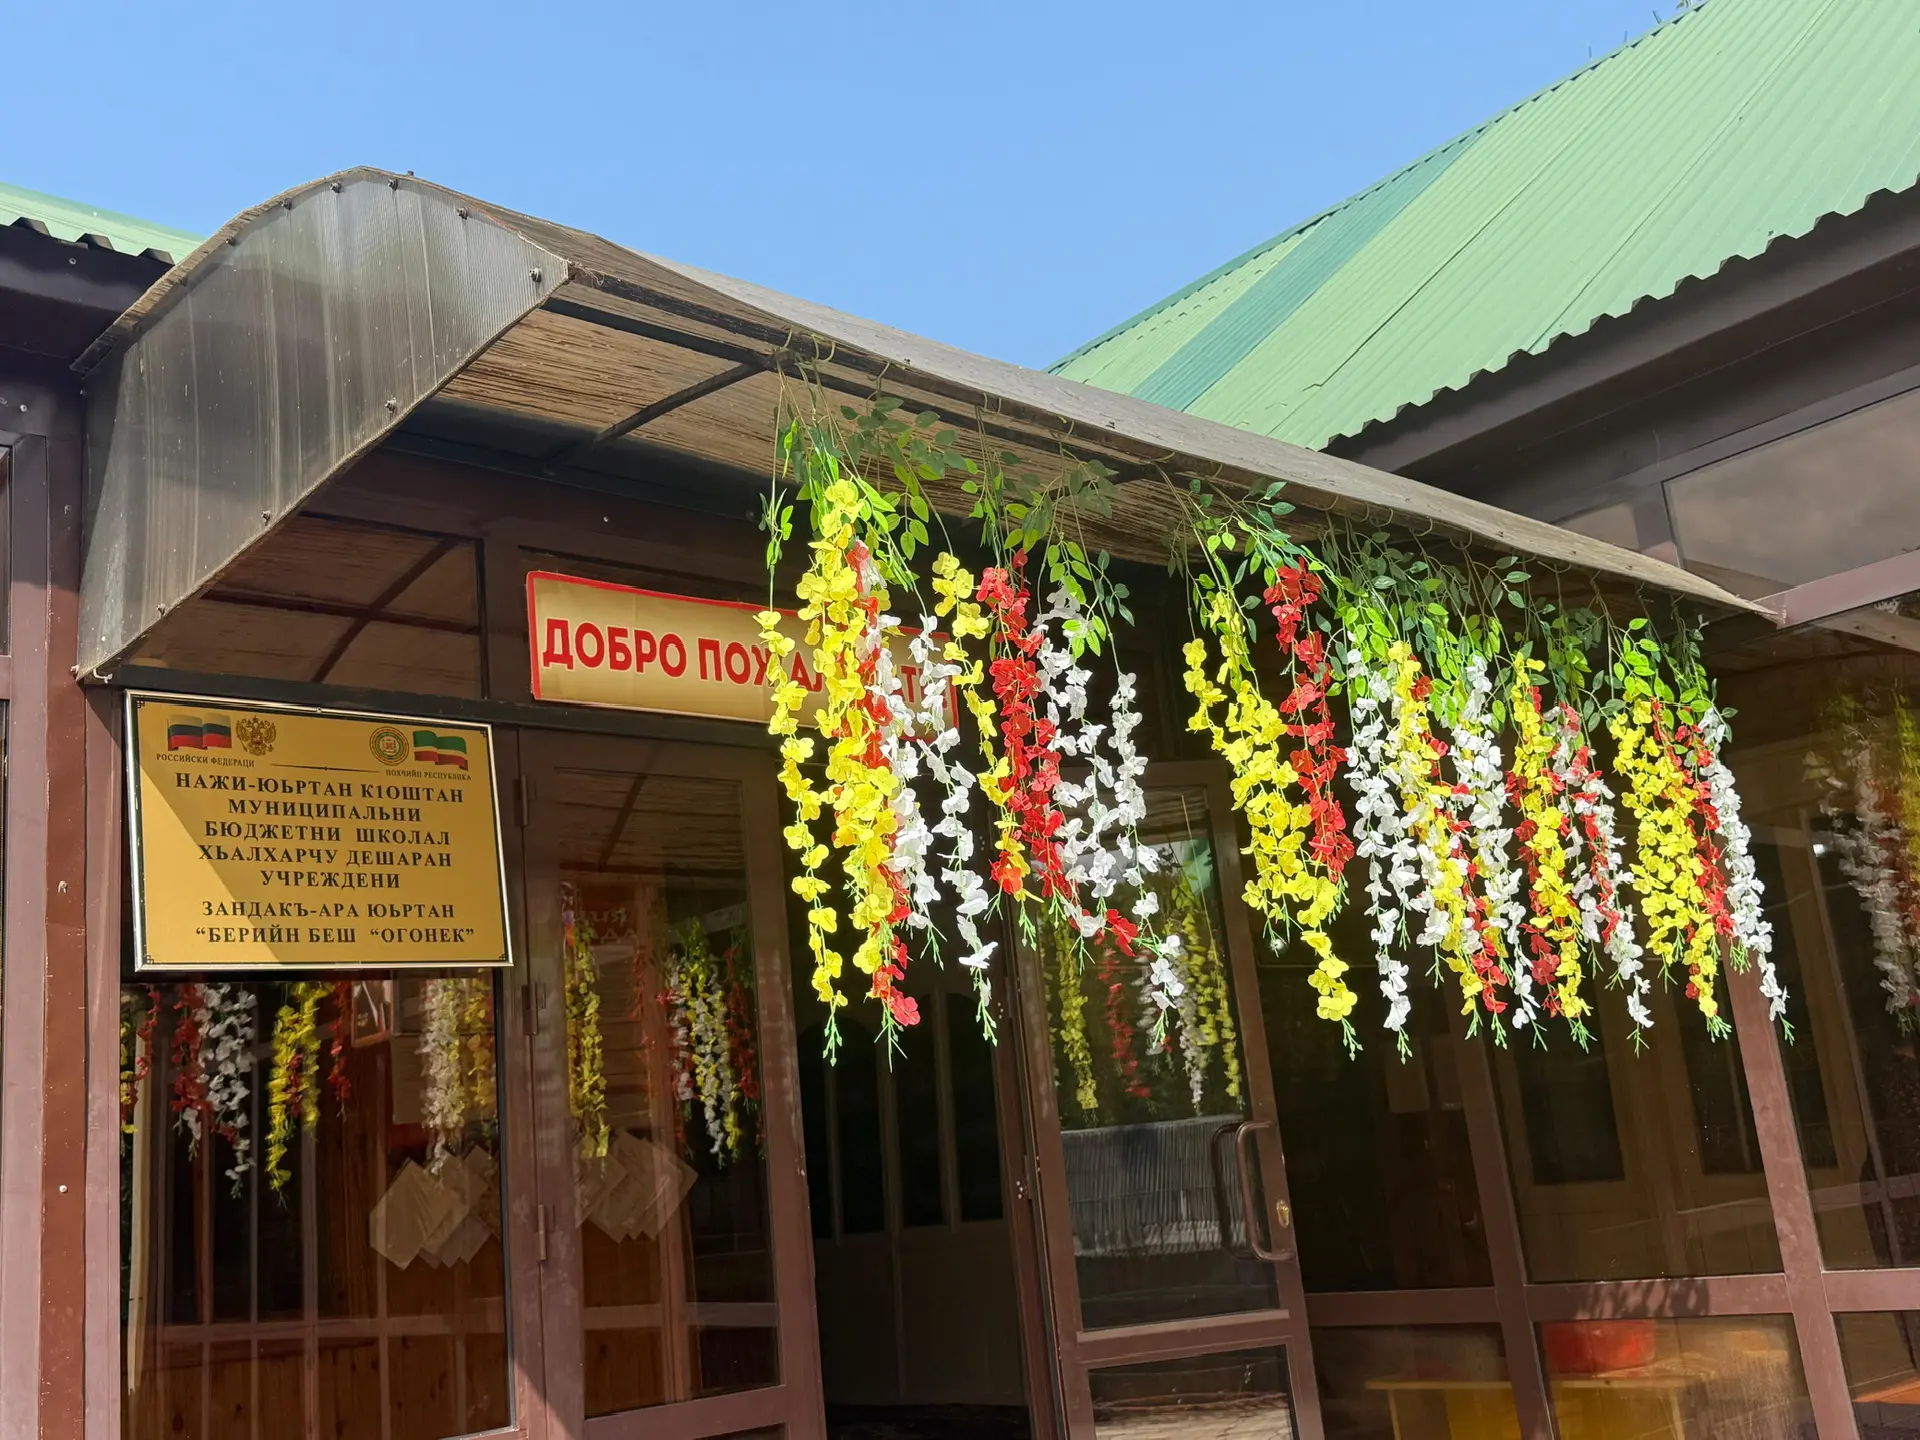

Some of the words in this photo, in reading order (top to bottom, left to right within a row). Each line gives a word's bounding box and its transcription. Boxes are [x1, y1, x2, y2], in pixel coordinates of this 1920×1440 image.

[542, 618, 688, 678] ДОБРО
[156, 753, 208, 765] РОССИЙСКИ
[211, 757, 255, 768] ФЕДЕРАЦИ
[176, 772, 352, 797] НАЖИ-ЮЬРТАН
[424, 770, 472, 781] РЕСПУБЛИКА
[228, 798, 421, 822] МУНИЦИПАЛЬНИ
[205, 821, 341, 842] БЮДЖЕТНИ
[356, 828, 450, 845] ШКОЛАЛ
[198, 844, 338, 864] ХЬАЛХАРЧУ
[346, 849, 452, 867] ДЕШАРАН
[260, 870, 400, 889] УЧРЕЖДЕНИ
[202, 901, 359, 919] ЗАНДАКЪ-АРА
[368, 903, 454, 918] ЮЬРТАН
[309, 928, 356, 943] БЕШ
